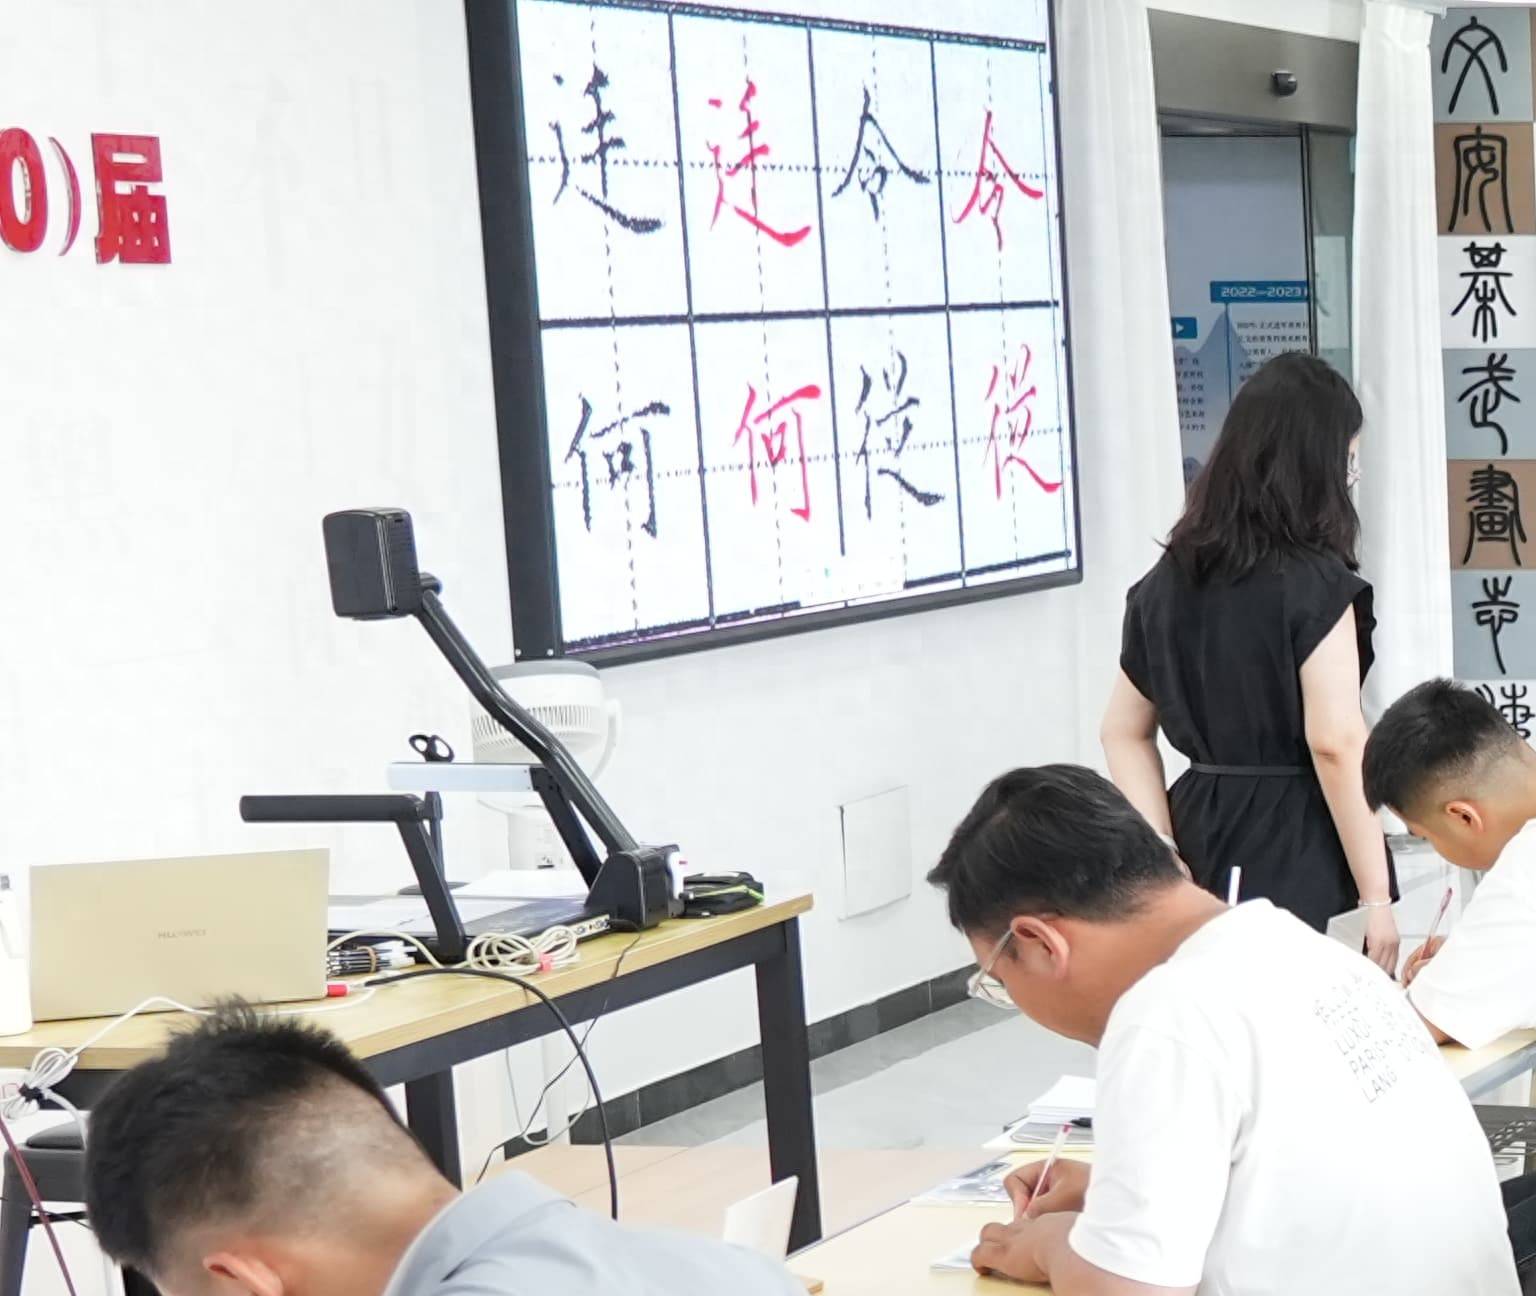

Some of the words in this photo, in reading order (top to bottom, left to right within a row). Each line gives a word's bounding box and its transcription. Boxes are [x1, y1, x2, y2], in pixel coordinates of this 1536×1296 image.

[1440, 15, 1508, 115] 文
[952, 109, 1043, 251] 令
[1447, 125, 1514, 234] 安
[564, 393, 670, 536] 何
[733, 385, 823, 521] 何
[1462, 463, 1527, 567] 畫
[1471, 575, 1520, 675] 志
